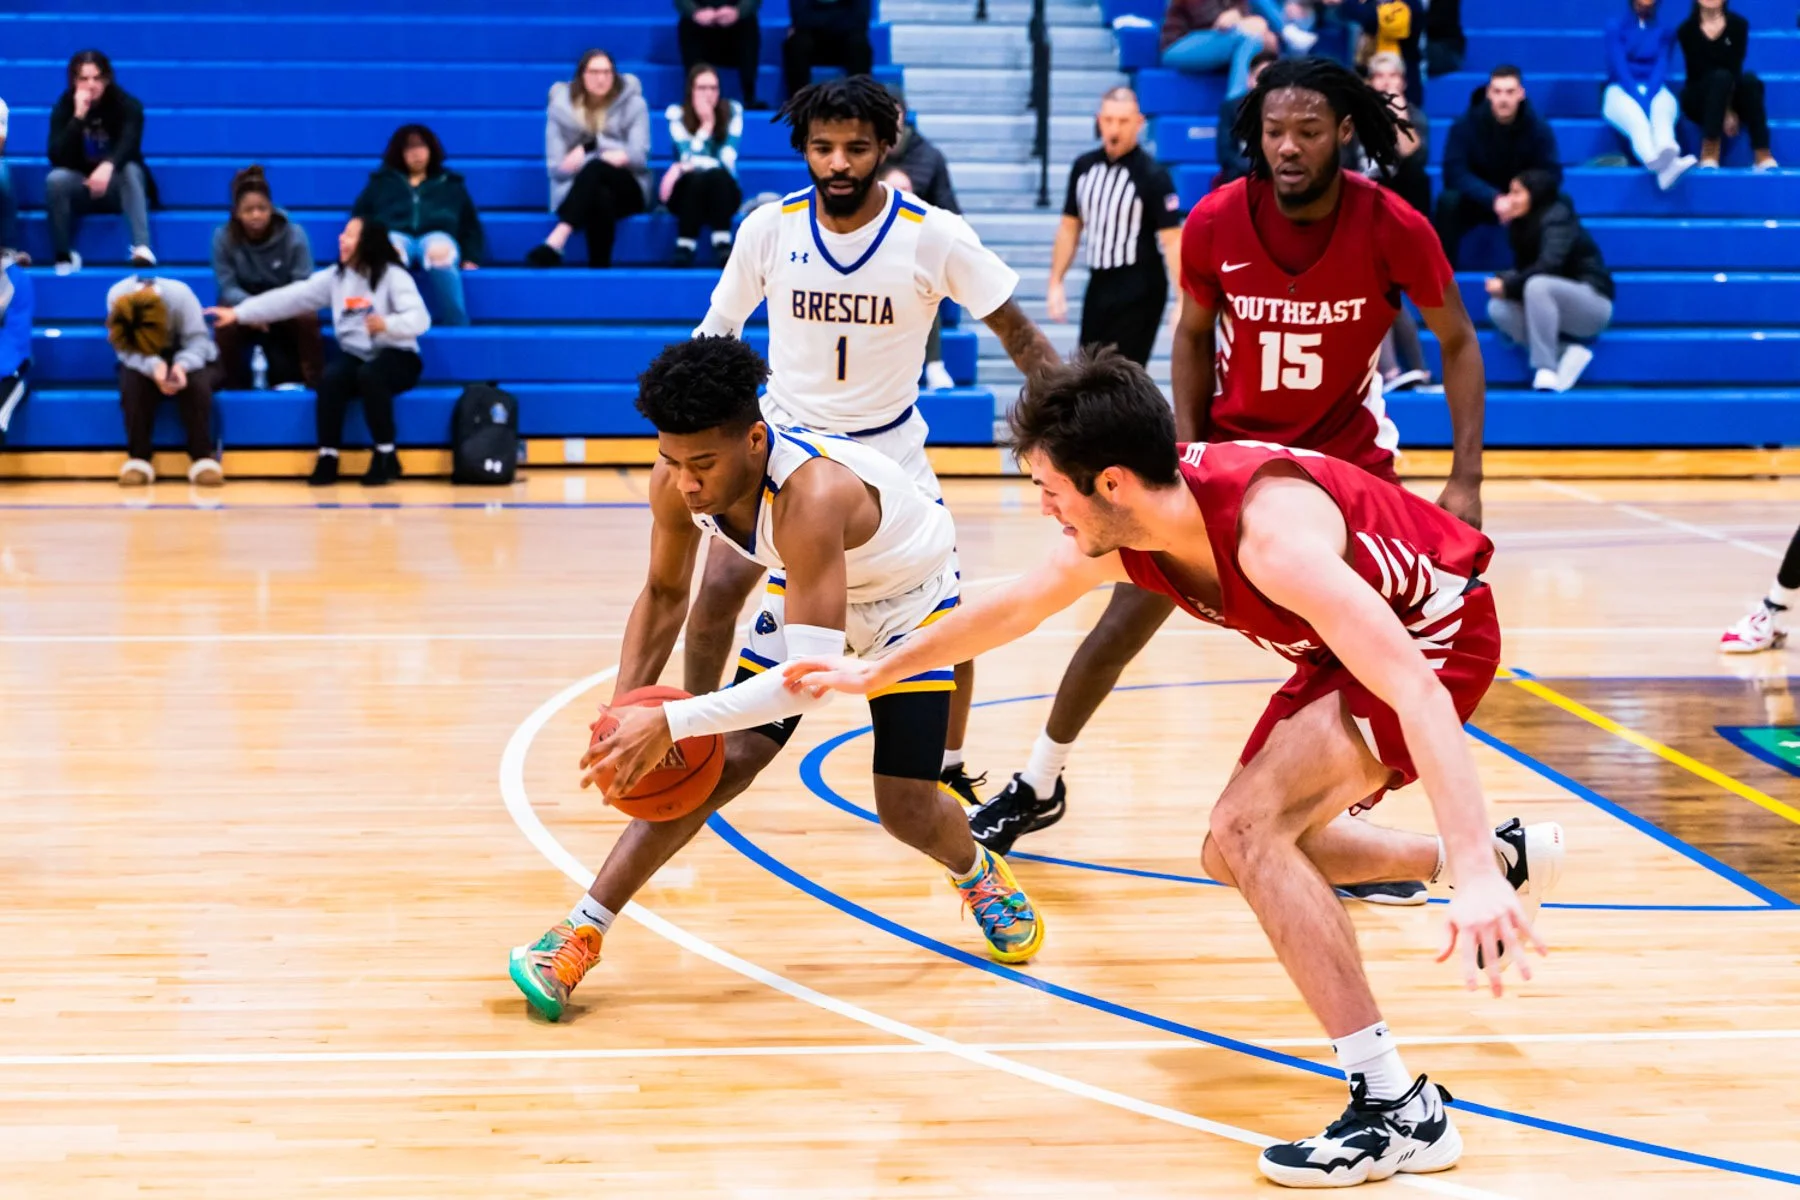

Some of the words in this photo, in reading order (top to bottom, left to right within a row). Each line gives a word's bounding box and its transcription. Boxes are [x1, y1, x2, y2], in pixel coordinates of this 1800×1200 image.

[792, 289, 894, 325] BRESCIA
[1227, 293, 1367, 325] OUTHEAST
[835, 335, 848, 381] 1
[1259, 331, 1323, 391] 15
